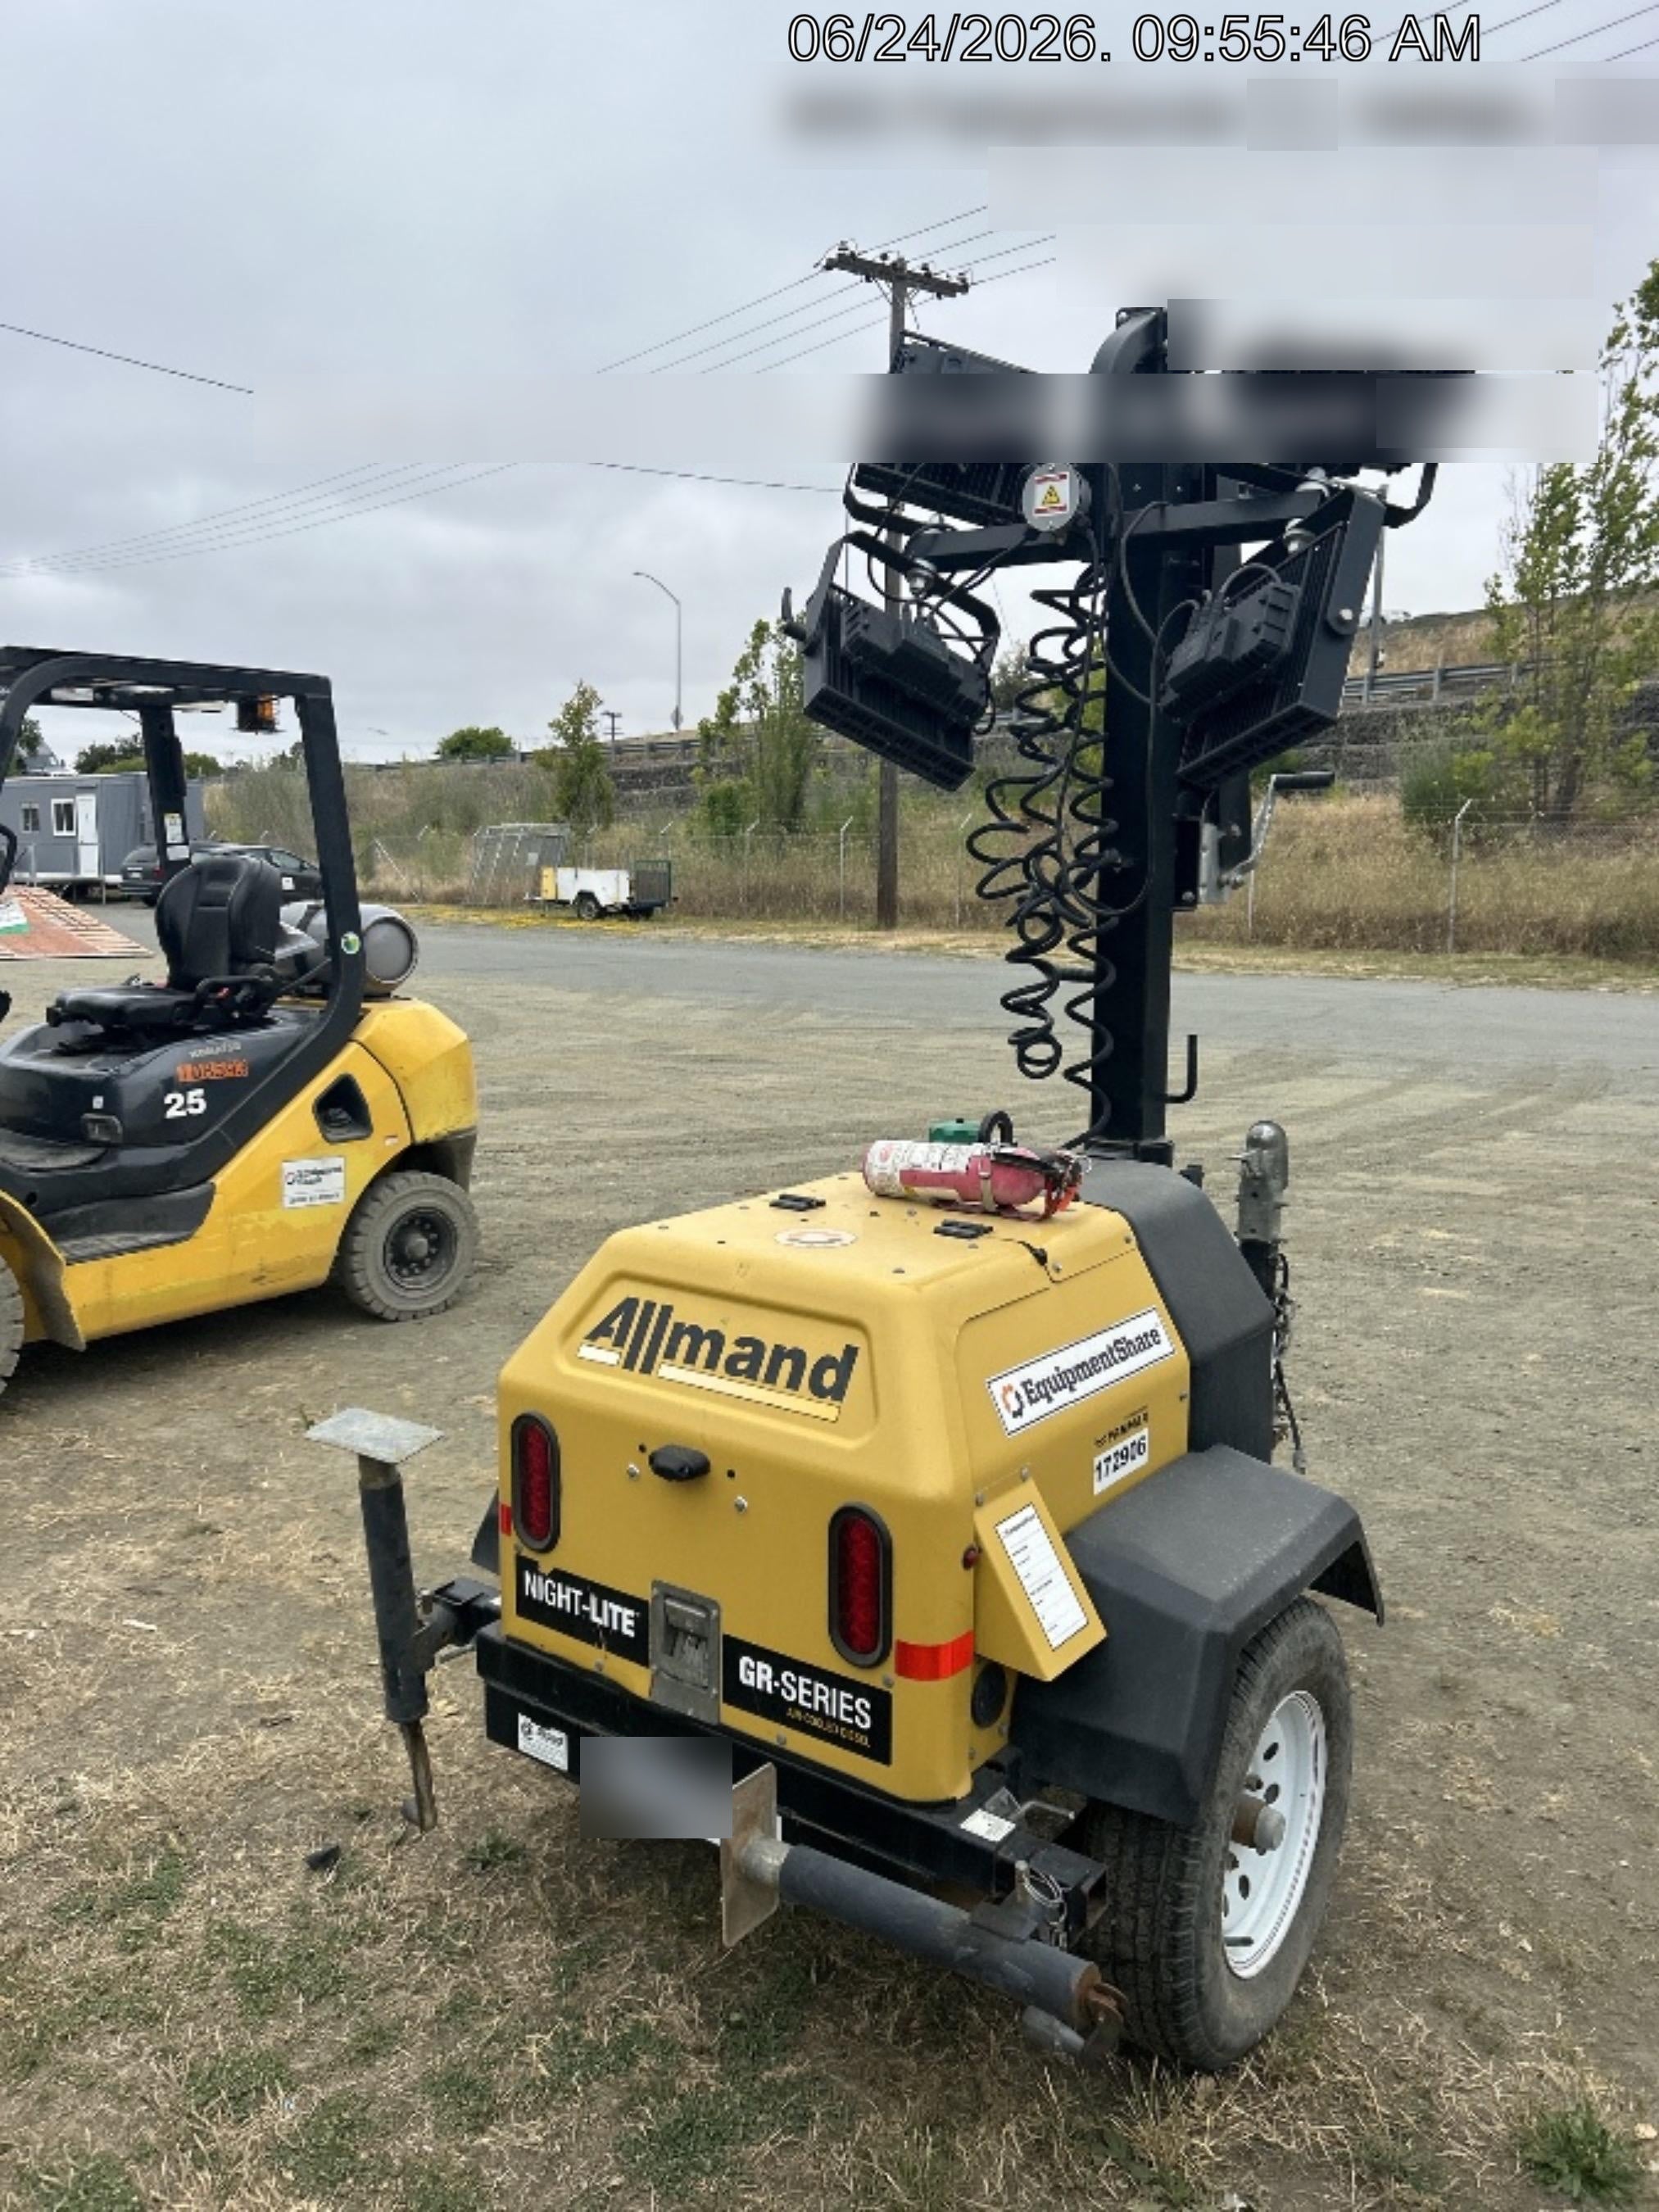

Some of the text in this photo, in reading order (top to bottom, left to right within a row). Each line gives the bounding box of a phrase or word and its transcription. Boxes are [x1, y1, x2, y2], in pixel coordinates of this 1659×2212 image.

[164, 1087, 207, 1119] 25
[584, 1296, 861, 1403] Allmand
[1020, 1326, 1162, 1407] EquipmentShare
[524, 1569, 636, 1639] NIGHT-LITE
[739, 1655, 872, 1729] GR-SERIES
